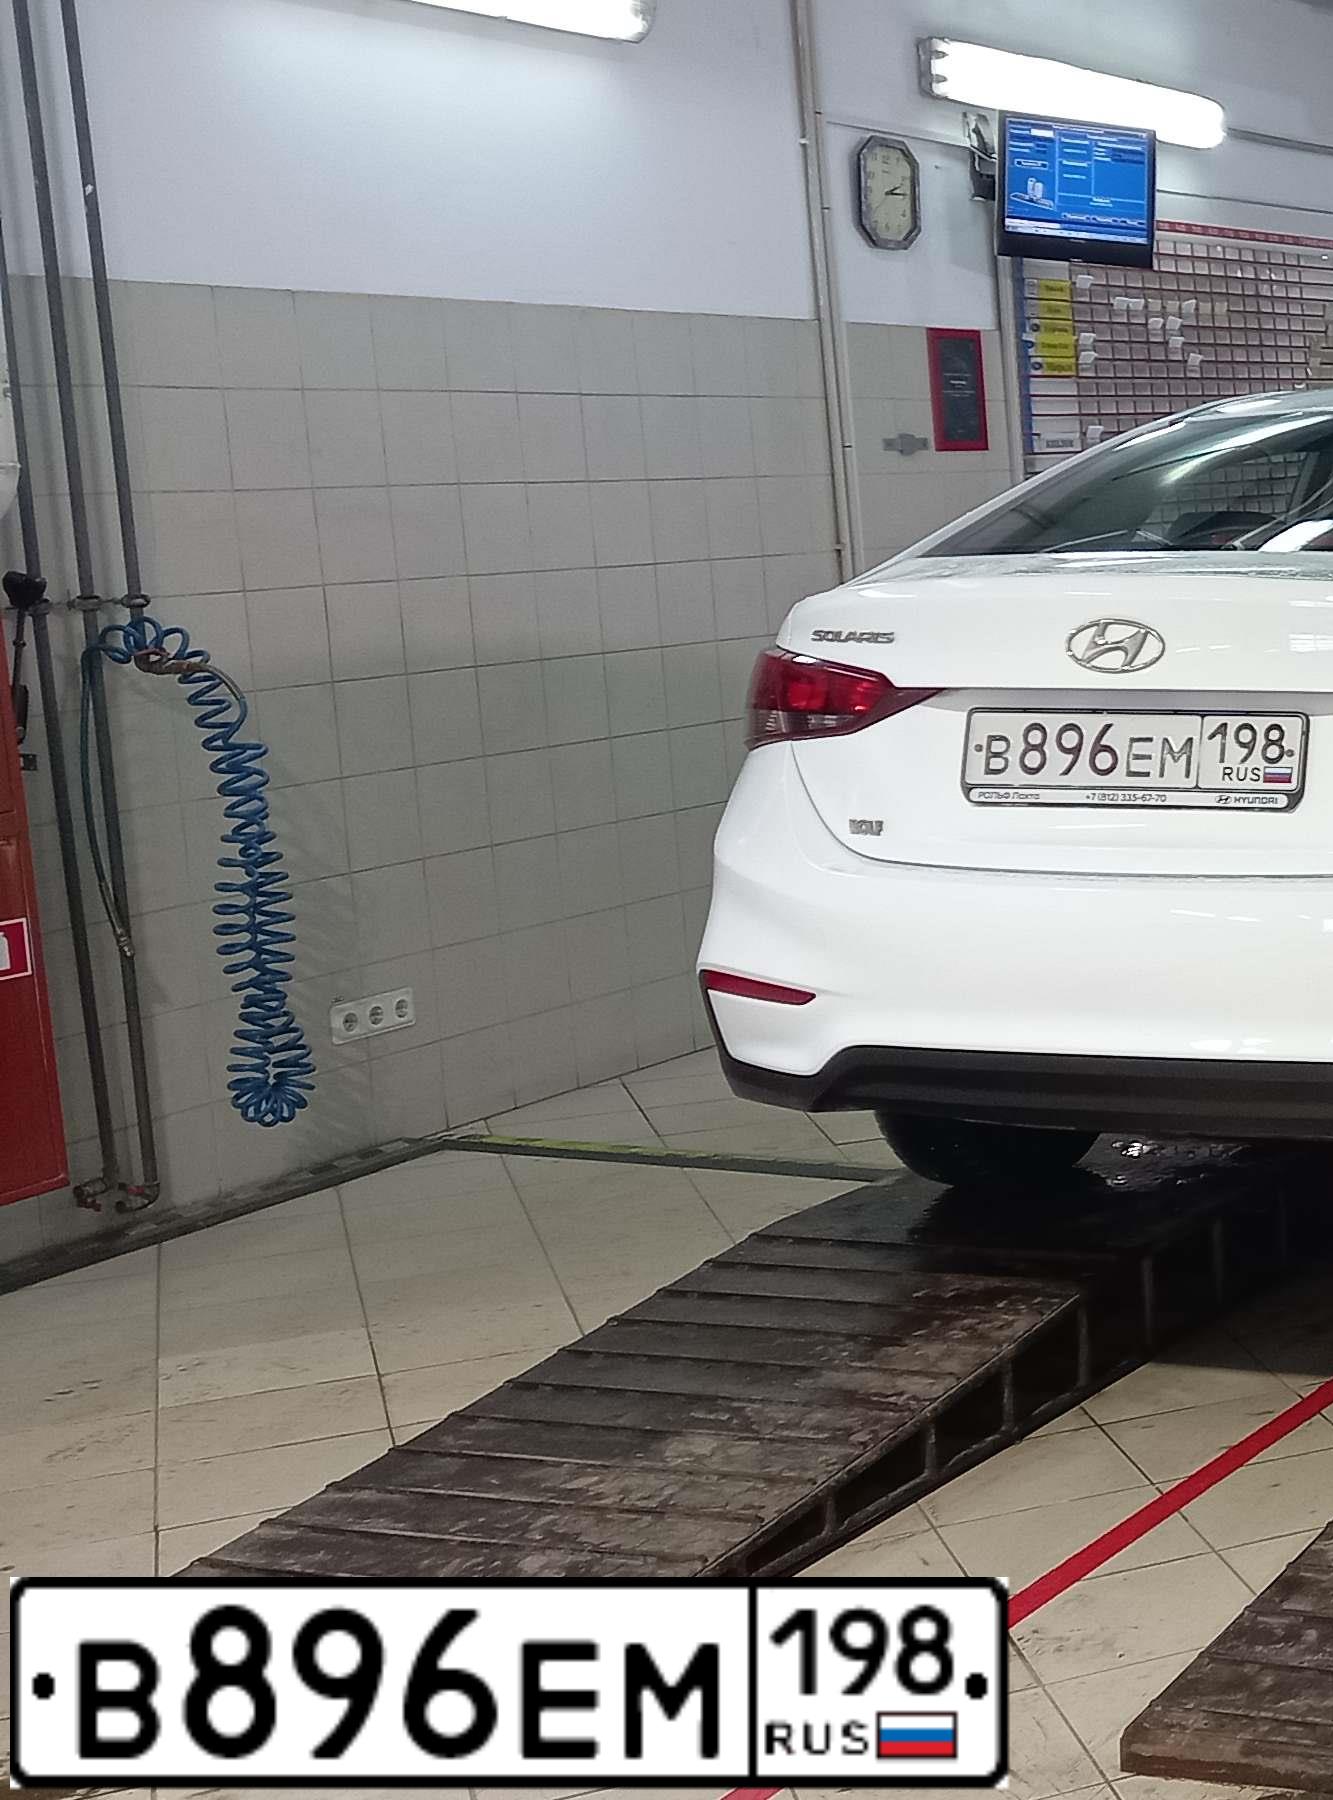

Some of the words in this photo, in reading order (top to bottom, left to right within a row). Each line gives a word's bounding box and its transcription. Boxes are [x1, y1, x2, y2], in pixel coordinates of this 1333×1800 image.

[811, 630, 895, 644] SOLARIS
[984, 722, 1193, 779] В896ЕМ
[1207, 721, 1284, 765] 198
[1222, 767, 1261, 783] RUS
[1086, 793, 1096, 801] +7
[1233, 796, 1279, 805] HYUNDAI
